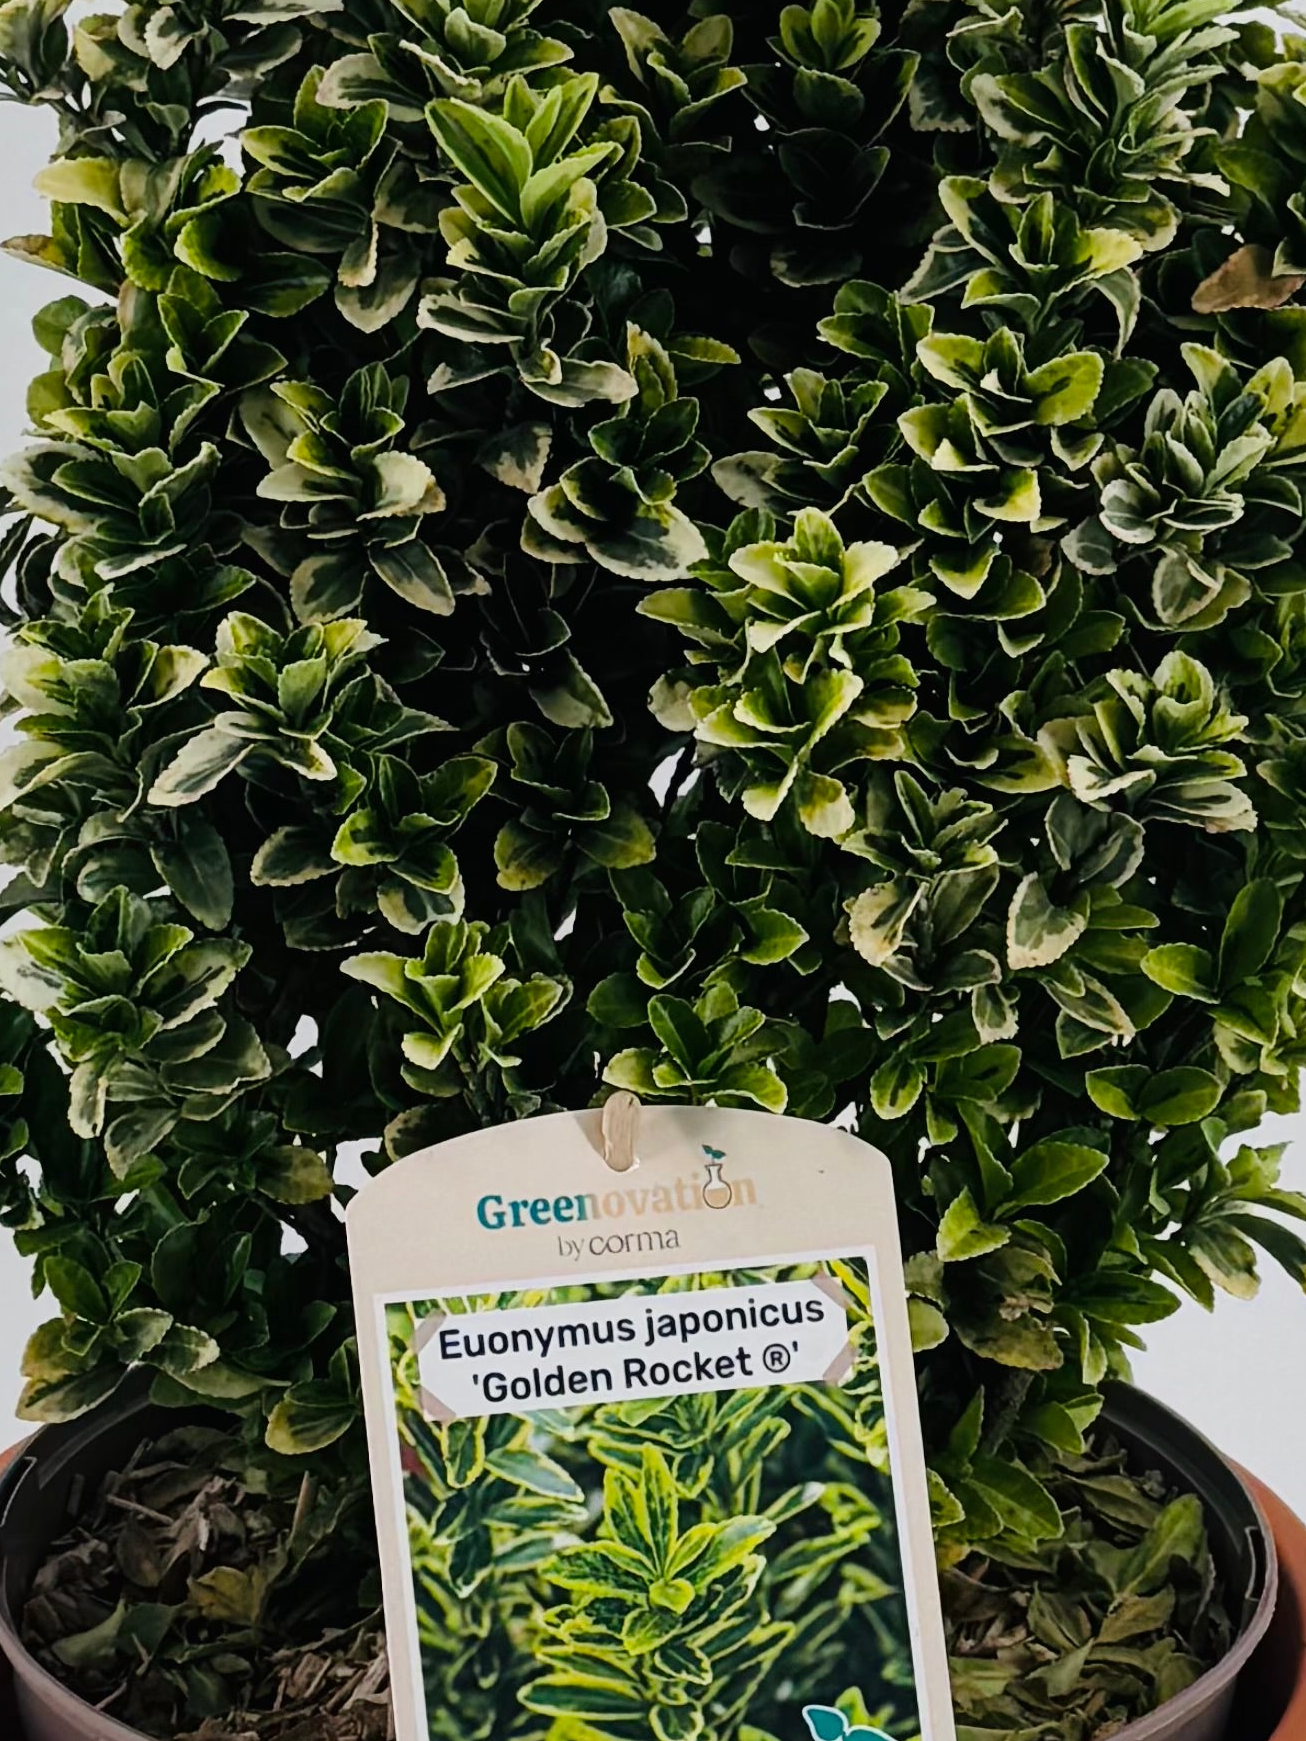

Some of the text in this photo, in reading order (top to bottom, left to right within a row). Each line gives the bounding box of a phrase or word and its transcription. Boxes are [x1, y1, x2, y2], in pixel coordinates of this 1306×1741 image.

[477, 1168, 757, 1230] Greenovation
[558, 1229, 680, 1262] by corma
[439, 1297, 825, 1359] Euonymus japonicus
[473, 1366, 613, 1403] 'Golden
[625, 1346, 752, 1389] Rocket
